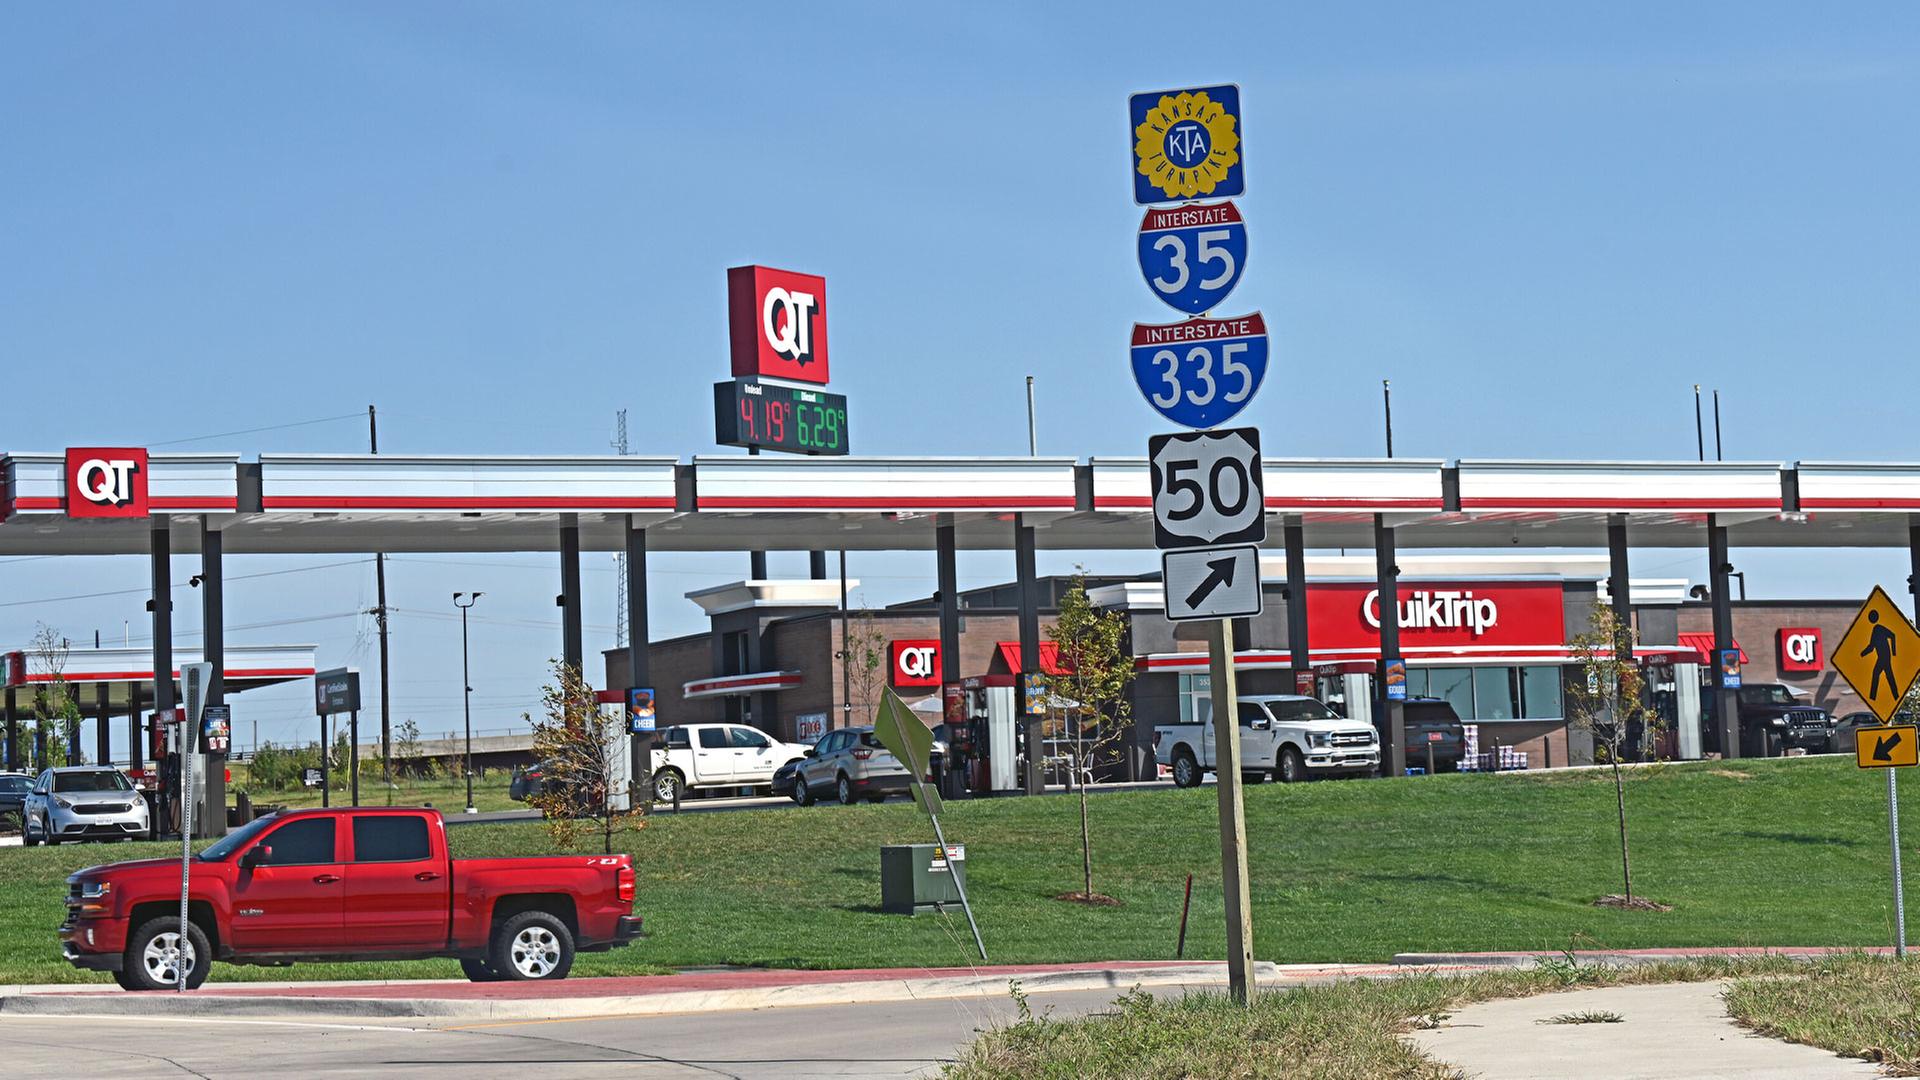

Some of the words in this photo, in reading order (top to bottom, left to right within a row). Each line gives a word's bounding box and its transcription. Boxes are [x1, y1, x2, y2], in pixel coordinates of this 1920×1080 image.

[1151, 102, 1217, 134] KANSAS
[1169, 125, 1206, 162] KTA
[1149, 149, 1227, 185] TURNPIKE
[1153, 207, 1229, 228] INTERSTATE
[1153, 229, 1235, 294] 35
[762, 286, 816, 361] QT
[1146, 320, 1250, 343] INTERSTATE
[1152, 342, 1252, 409] 335
[77, 458, 137, 505] QT
[1166, 456, 1249, 521] 50
[899, 647, 936, 678] QT
[1786, 634, 1816, 663] QT
